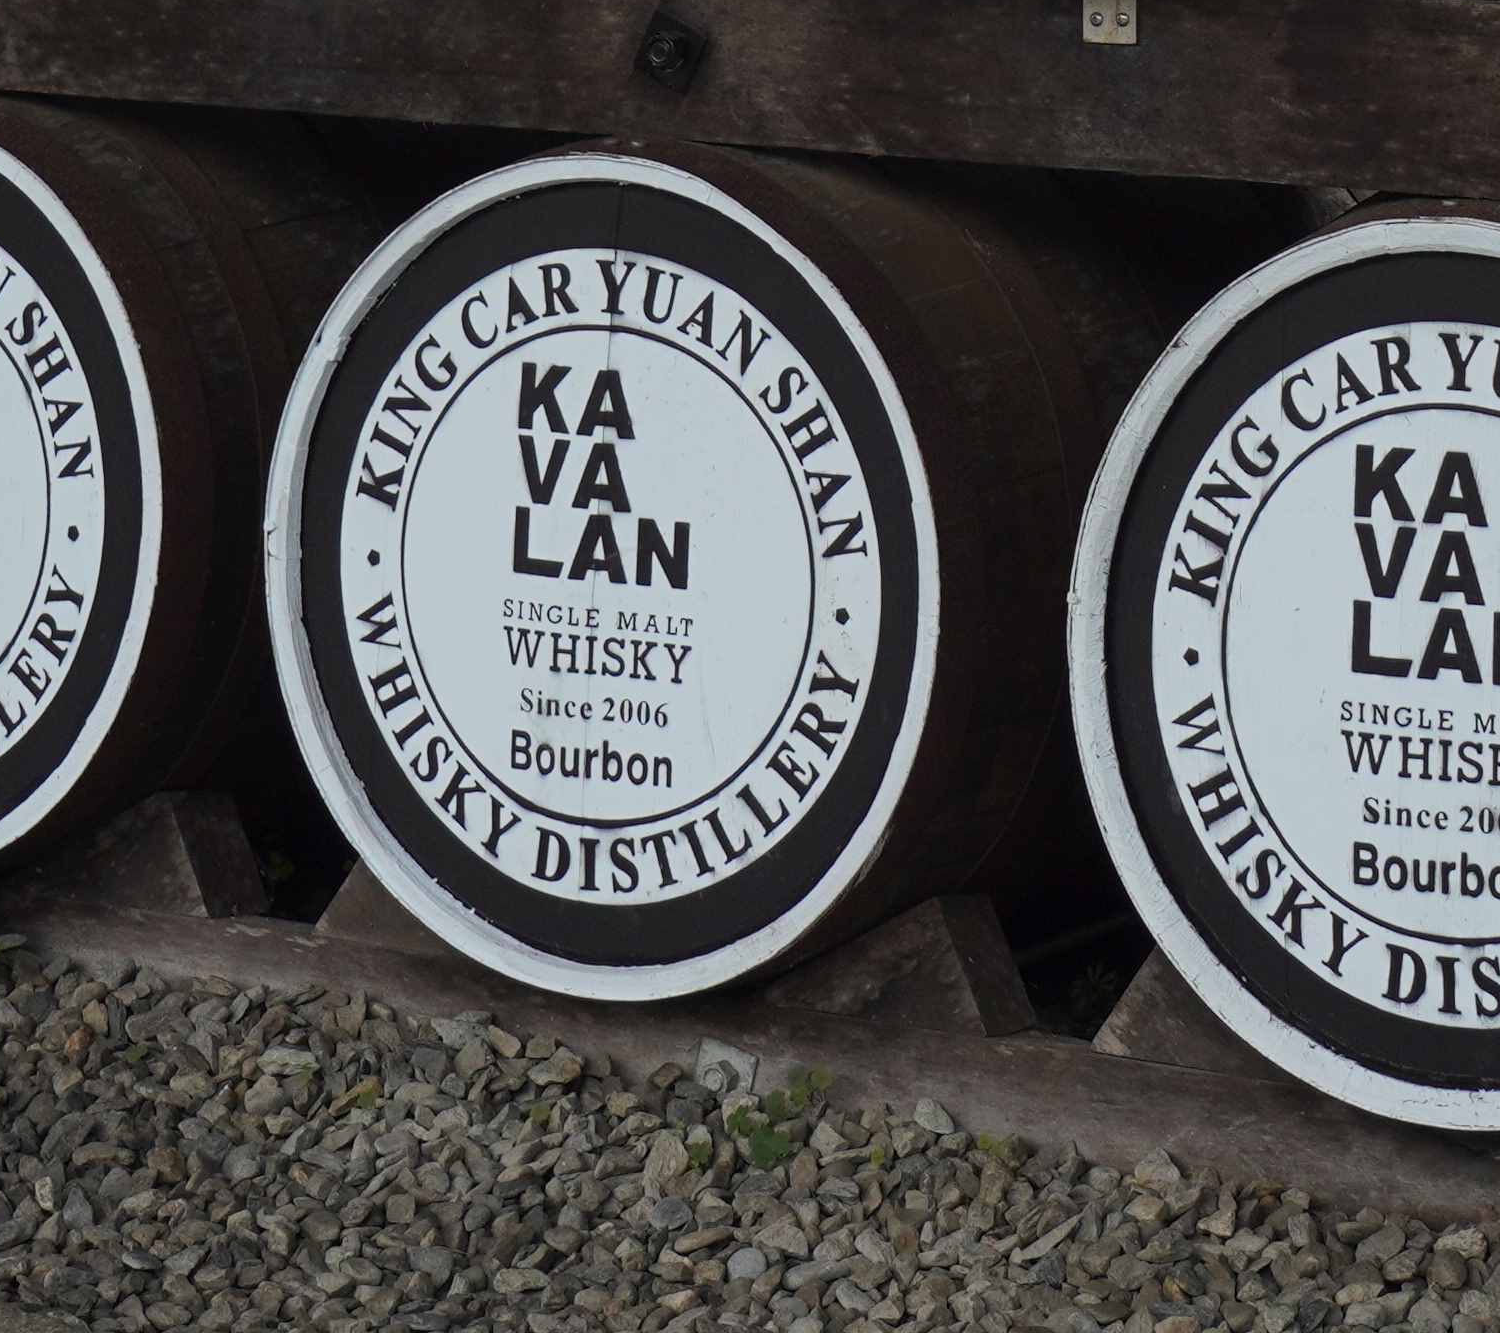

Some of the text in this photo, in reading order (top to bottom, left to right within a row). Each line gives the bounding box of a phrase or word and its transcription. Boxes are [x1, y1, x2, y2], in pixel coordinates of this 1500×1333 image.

[5, 302, 94, 478] SHAN
[356, 259, 867, 558] KING CAR YUAN SHAN
[518, 362, 635, 439] KA
[519, 435, 631, 513] VA
[1168, 416, 1279, 607] KING
[1281, 337, 1421, 431] CAR
[1354, 445, 1488, 527] KA
[513, 506, 690, 590] LAN
[1354, 523, 1485, 606] VA
[504, 599, 693, 636] SINGLE MALT
[504, 626, 691, 684] WHISKY
[357, 593, 859, 893] WHISKY DISTILLERY
[521, 688, 667, 727] Since 2006
[1341, 701, 1453, 731] SINGLE
[511, 730, 672, 787] Bourbon
[1172, 693, 1369, 977] WHISKY
[1364, 797, 1448, 830] Since
